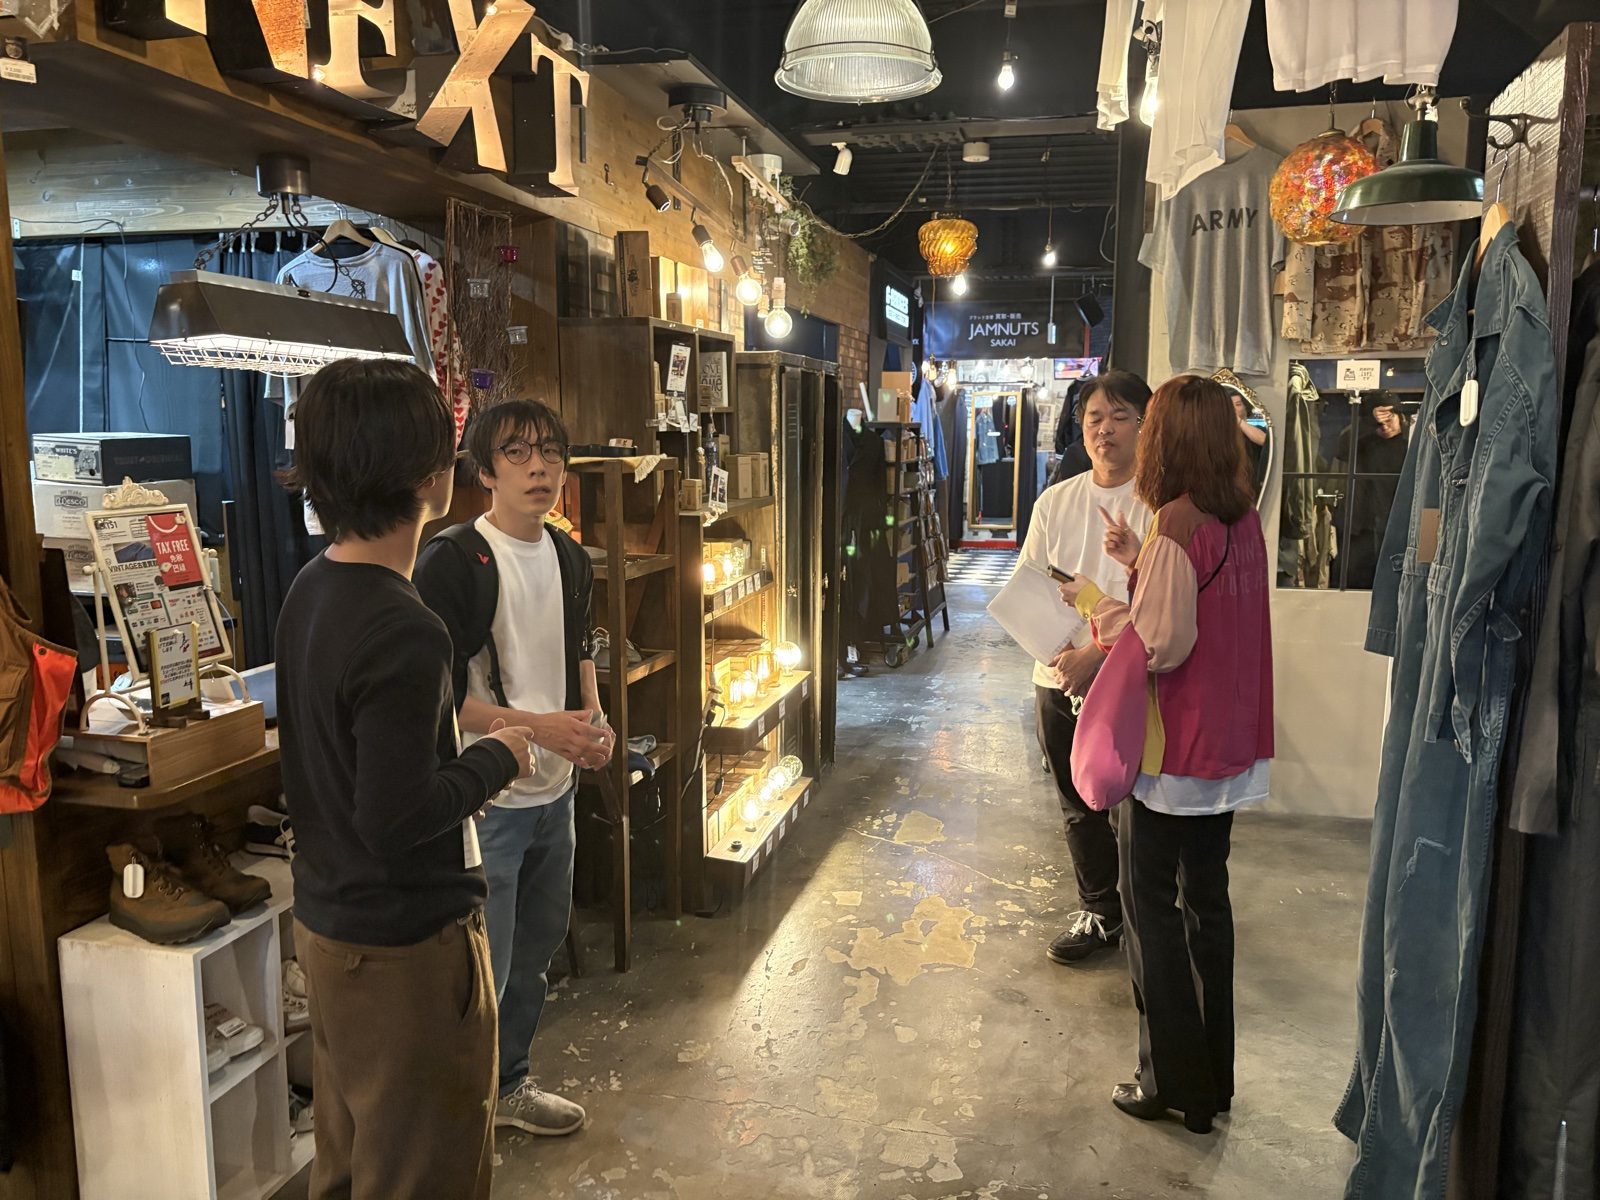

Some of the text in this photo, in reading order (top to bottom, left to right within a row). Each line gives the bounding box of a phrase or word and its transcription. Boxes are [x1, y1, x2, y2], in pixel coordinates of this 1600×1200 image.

[1191, 207, 1258, 236] ARMY
[967, 321, 1039, 341] JAMNUTS
[990, 338, 1016, 347] SAKAI
[156, 538, 189, 554] TAX FREE
